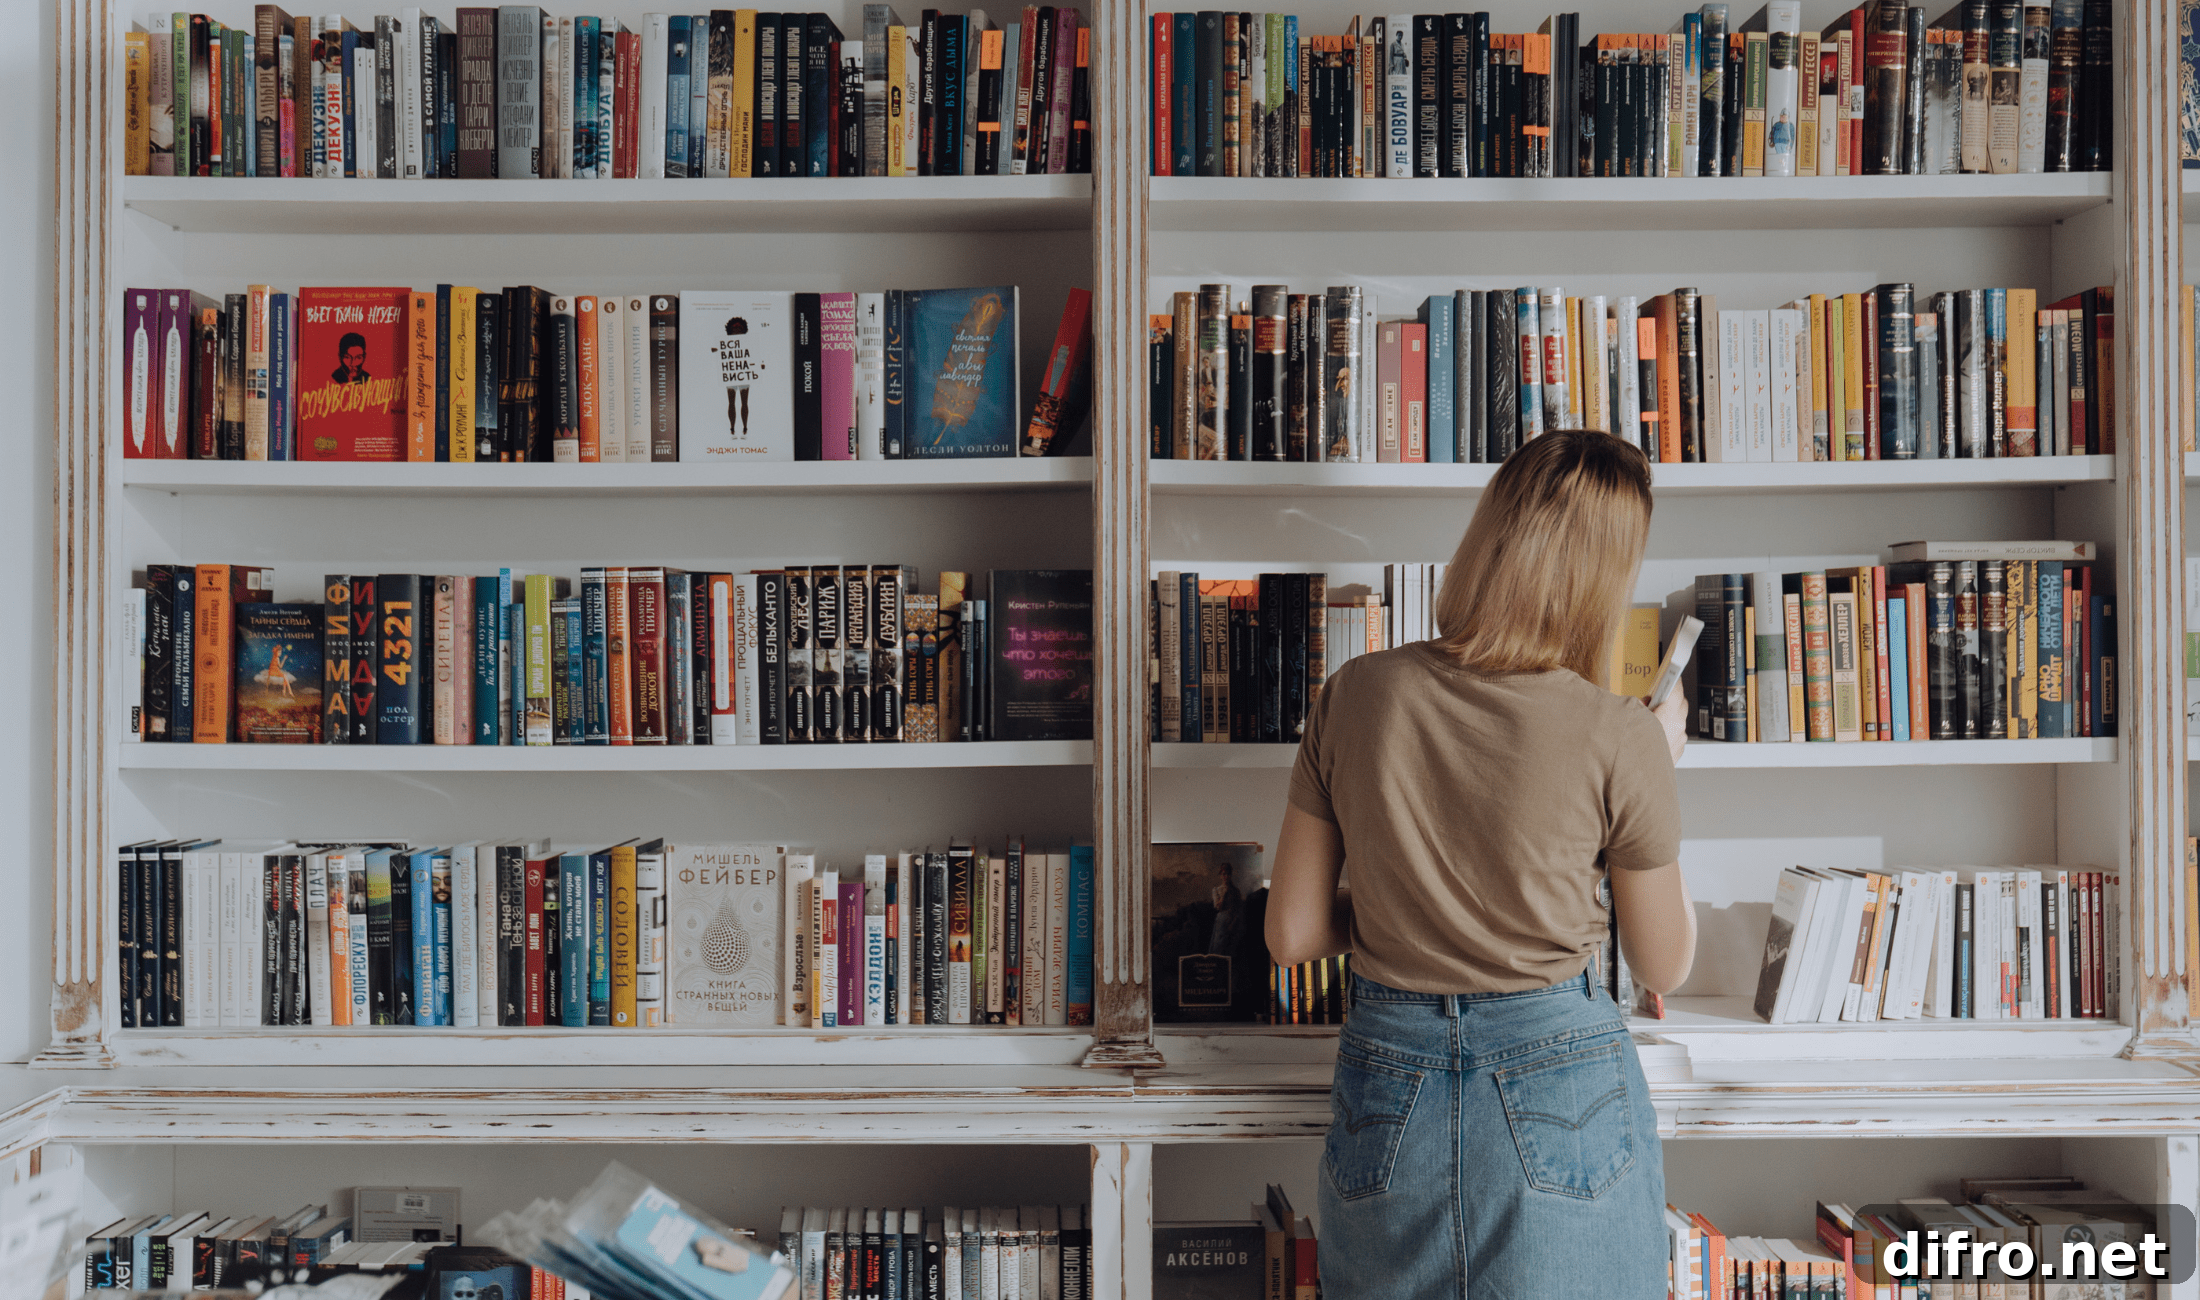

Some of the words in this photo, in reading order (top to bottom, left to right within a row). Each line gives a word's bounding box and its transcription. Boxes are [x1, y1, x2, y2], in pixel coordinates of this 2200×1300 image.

[424, 26, 432, 74] ГЛУБИНЕ
[762, 27, 775, 57] ПОЖАРЫ
[925, 20, 934, 72] барабанщик
[946, 28, 957, 68] ДЫМА
[1036, 19, 1049, 69] барабанщик
[1421, 37, 1437, 66] СЕРДЦА
[1805, 44, 1815, 73] ГЕССЕ
[1841, 41, 1850, 80] ГОЛДИНГ
[463, 60, 491, 84] ПРАВДА
[762, 58, 774, 80] ТЛЕЮТ
[1302, 48, 1310, 81] БАЛЛАРД
[1673, 44, 1682, 87] ВОННЕГУТ
[424, 77, 433, 115] САМОЙ
[463, 84, 467, 104] О
[470, 84, 492, 107] ДЕЛЕ
[762, 82, 777, 114] ПОВСЮДУ
[924, 73, 933, 104] Другой
[945, 72, 955, 107] ВКУС
[1035, 71, 1045, 102] Другой
[1301, 82, 1310, 112] ДЖЕЙМС
[1421, 68, 1436, 100] СМЕРТЬ
[1673, 89, 1681, 109] КУРТ
[313, 92, 326, 164] ДЕКУЭН
[328, 91, 342, 162] ДЕКУЭН
[426, 118, 433, 126] В
[466, 107, 488, 127] ГАРРИ
[600, 94, 610, 164] ДЮБУА
[1392, 91, 1407, 145] БОВУАР
[1421, 105, 1436, 130] БОУЭН
[460, 130, 494, 150] КВЕБЕРТА
[1395, 150, 1409, 164] ДЕ
[1421, 133, 1435, 173] ЭЛИЗАБЕТ
[559, 322, 567, 382] УСКОЛЬЗАЕТ
[632, 326, 642, 384] ДЫХАНИЯ
[658, 320, 666, 360] ТУРИСТ
[720, 340, 740, 350] ВСЯ
[721, 349, 750, 359] ВАША
[2071, 322, 2081, 352] МОЭМ
[722, 361, 755, 371] НЕНА-
[722, 371, 759, 382] ВИСТЬ
[804, 361, 812, 393] ПОКОЙ
[560, 386, 568, 424] МОРГАН
[633, 387, 642, 426] УРОКИ
[658, 365, 666, 432] СЛУЧАЙНЫЙ
[1993, 371, 2003, 410] Миллер
[608, 390, 616, 435] КАТУШКА
[1993, 412, 2004, 441] Генри
[914, 446, 954, 455] ЛЕСЛИ
[960, 444, 1009, 452] УОЛТОН
[616, 587, 625, 632] ПИЛЧЕР
[646, 587, 656, 632] ПИЛЧЕР
[2051, 575, 2061, 607] ДЕТИ
[250, 617, 278, 625] ТАЙНЫ
[280, 618, 311, 626] СЕРДЦА
[586, 587, 594, 635] РОЗАМУНДА
[594, 588, 603, 633] ПИЛЧЕР
[638, 586, 646, 635] РОЗАМУНДА
[695, 583, 706, 657] АРМИНУТА
[735, 585, 747, 670] ПРОЩАЛЬНЫЙ
[748, 605, 758, 648] ФОКУС
[765, 581, 777, 663] БЕЛЬКАНТО
[790, 583, 798, 642] КОРОЛЕВСКИЙ
[1369, 607, 1378, 640] РЕМАРК
[1838, 604, 1849, 643] ХЕЛЛЕР
[2039, 574, 2050, 649] НИЧЕЙНОГО
[384, 601, 412, 686] 4321
[438, 605, 450, 683] СИРЕНА
[1863, 623, 1872, 651] ИЗГОИ
[2051, 613, 2062, 648] ОТЦА
[1625, 663, 1651, 678] Вор
[2040, 665, 2050, 700] АРНО
[2050, 655, 2062, 702] ШМИДТ
[182, 675, 190, 707] СЕМЬИ
[639, 660, 648, 722] ВОЗВРАЩЕНИЕ
[647, 672, 658, 711] ДОМОЙ
[679, 866, 776, 885] ФЕЙБЕР
[693, 854, 760, 865] МИШЕЛЬ
[309, 868, 325, 908] ПЛАЧ
[485, 881, 494, 918] ЖИЗНЬ
[565, 872, 573, 907] которая
[955, 860, 966, 933] СИВИЛЛА
[1030, 867, 1040, 903] Эрдрич
[1054, 867, 1063, 912] ЛАРОУЗ
[500, 905, 512, 939] Тана
[511, 906, 522, 920] за
[1029, 906, 1038, 933] Луиза
[1077, 871, 1089, 938] КОМПАС
[510, 921, 523, 949] Тень
[575, 926, 582, 936] не
[615, 886, 632, 987] СОЛОВЕЙ
[1053, 926, 1063, 970] ЭРДРИЧ
[352, 942, 367, 1005] ФЛОРЕСКУ
[485, 921, 495, 990] ВОЗМОЖНАЯ
[869, 933, 883, 1005] ХЭДДОН
[420, 945, 433, 1017] Флэнаган
[676, 991, 735, 1001] СТРАННЫХ
[740, 993, 779, 1001] НОВЫХ
[709, 980, 746, 989] КНИГА
[1023, 957, 1033, 1005] КРУГЛЫЙ
[1052, 975, 1061, 1012] ЛУИЗА
[708, 1002, 747, 1012] ВЕЩЕЙ
[1182, 1239, 1232, 1248] ВАСИЛИЙ
[929, 1264, 938, 1288] МЕСТЬ
